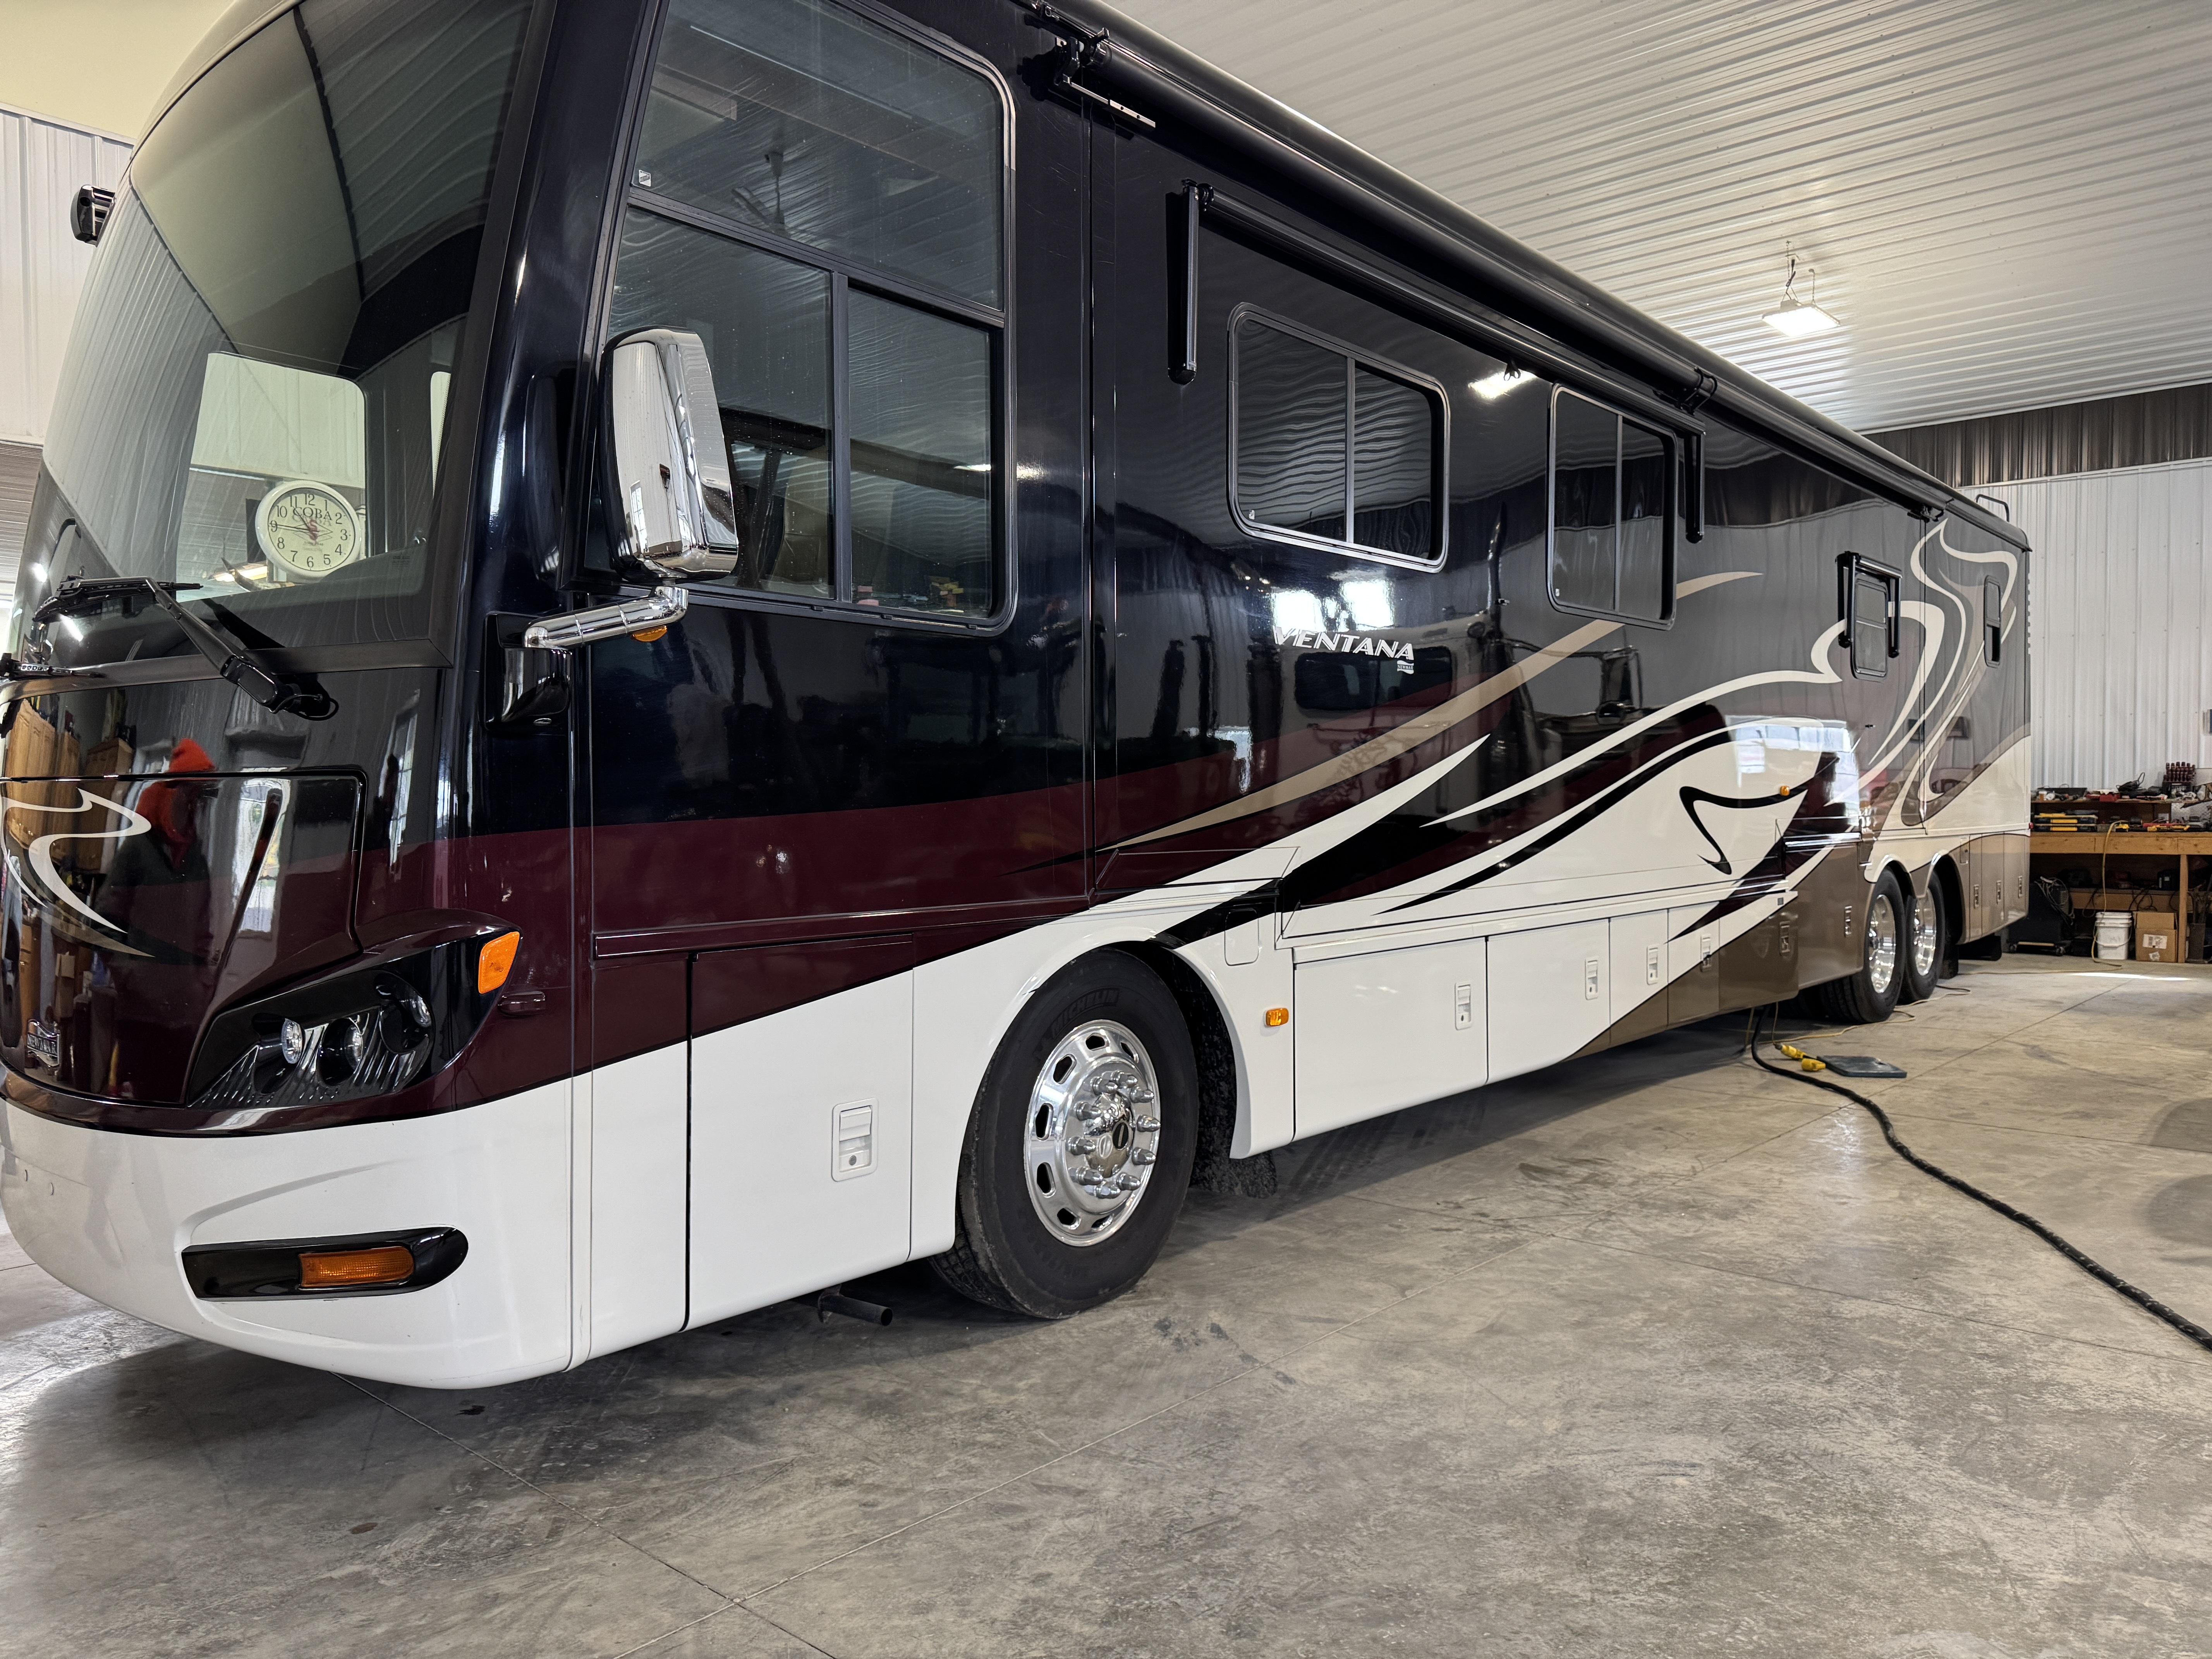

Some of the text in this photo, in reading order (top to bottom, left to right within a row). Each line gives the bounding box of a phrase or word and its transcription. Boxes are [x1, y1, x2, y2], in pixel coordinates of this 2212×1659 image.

[290, 495, 297, 508] 11
[304, 493, 315, 506] 12
[324, 499, 328, 511] 1
[276, 505, 287, 518] 10
[293, 507, 332, 520] COBA
[335, 512, 343, 525] 2
[271, 520, 278, 532] 9
[340, 529, 348, 541] 3
[277, 537, 285, 550] 8
[335, 544, 342, 555] 4
[290, 550, 298, 562] 7
[307, 556, 314, 568] 6
[323, 554, 331, 565] 5
[1273, 625, 1414, 660] VENTANA
[1051, 989, 1119, 1039] MICHELIN
